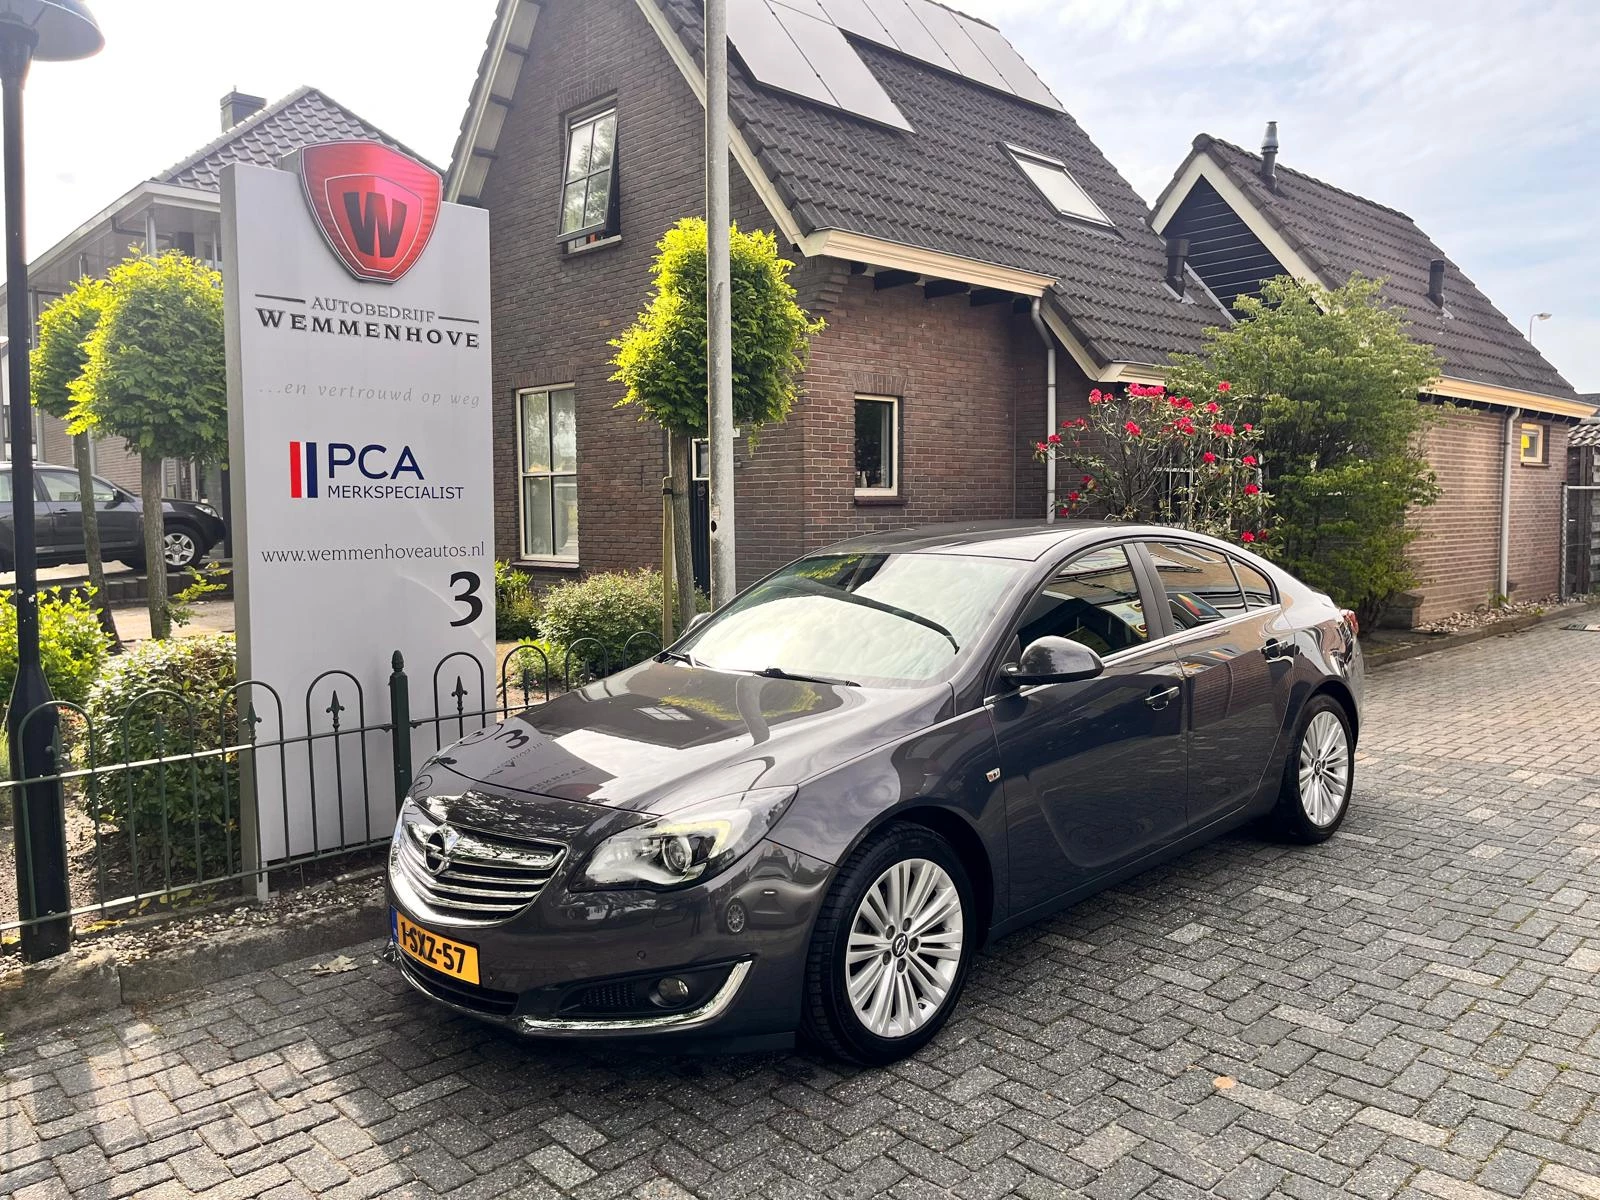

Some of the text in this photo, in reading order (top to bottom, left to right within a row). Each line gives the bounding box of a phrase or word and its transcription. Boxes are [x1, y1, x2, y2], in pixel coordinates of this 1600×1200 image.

[342, 191, 408, 259] W
[255, 308, 480, 348] WEMMENHOVE
[311, 296, 436, 322] AUTOBEDRIJF
[318, 385, 413, 403] vertrouwd
[421, 391, 442, 405] op
[450, 392, 481, 409] weg
[327, 442, 425, 481] PCA
[327, 484, 465, 500] MERKSPECIALIST
[261, 541, 485, 563] www.wemmenhoveautos.nl
[449, 570, 484, 628] 3
[400, 921, 466, 974] 1-SXZ-57
